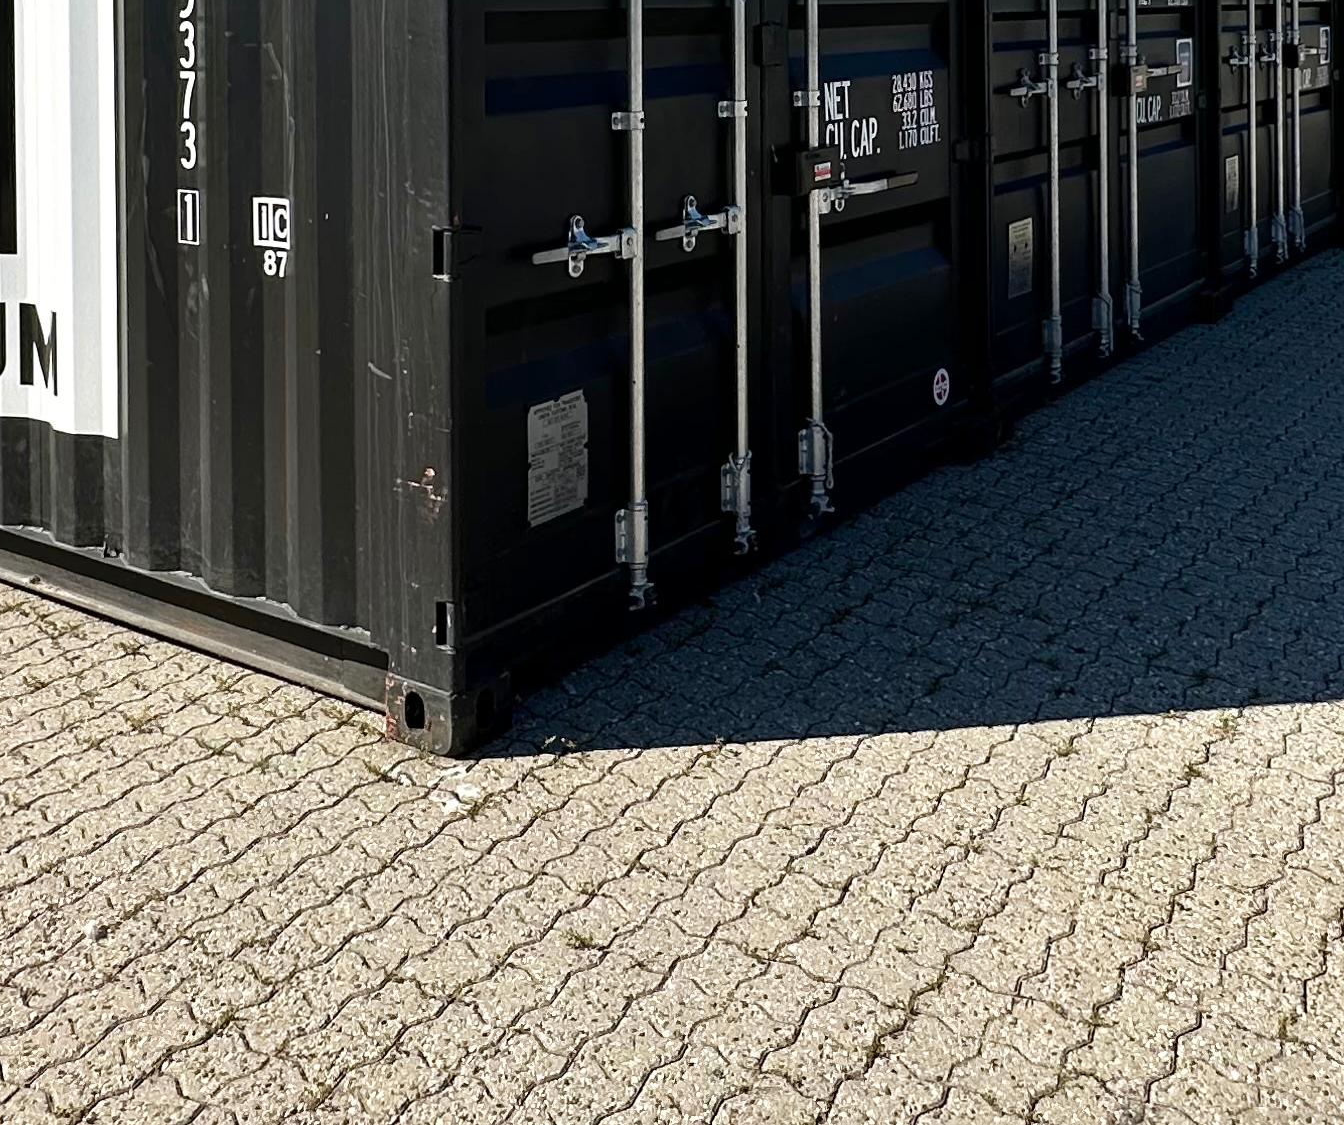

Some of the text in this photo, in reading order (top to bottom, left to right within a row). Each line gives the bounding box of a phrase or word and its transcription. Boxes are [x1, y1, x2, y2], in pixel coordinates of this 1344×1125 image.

[823, 80, 851, 122] NET
[851, 117, 881, 158] CAP.
[263, 249, 288, 278] 87
